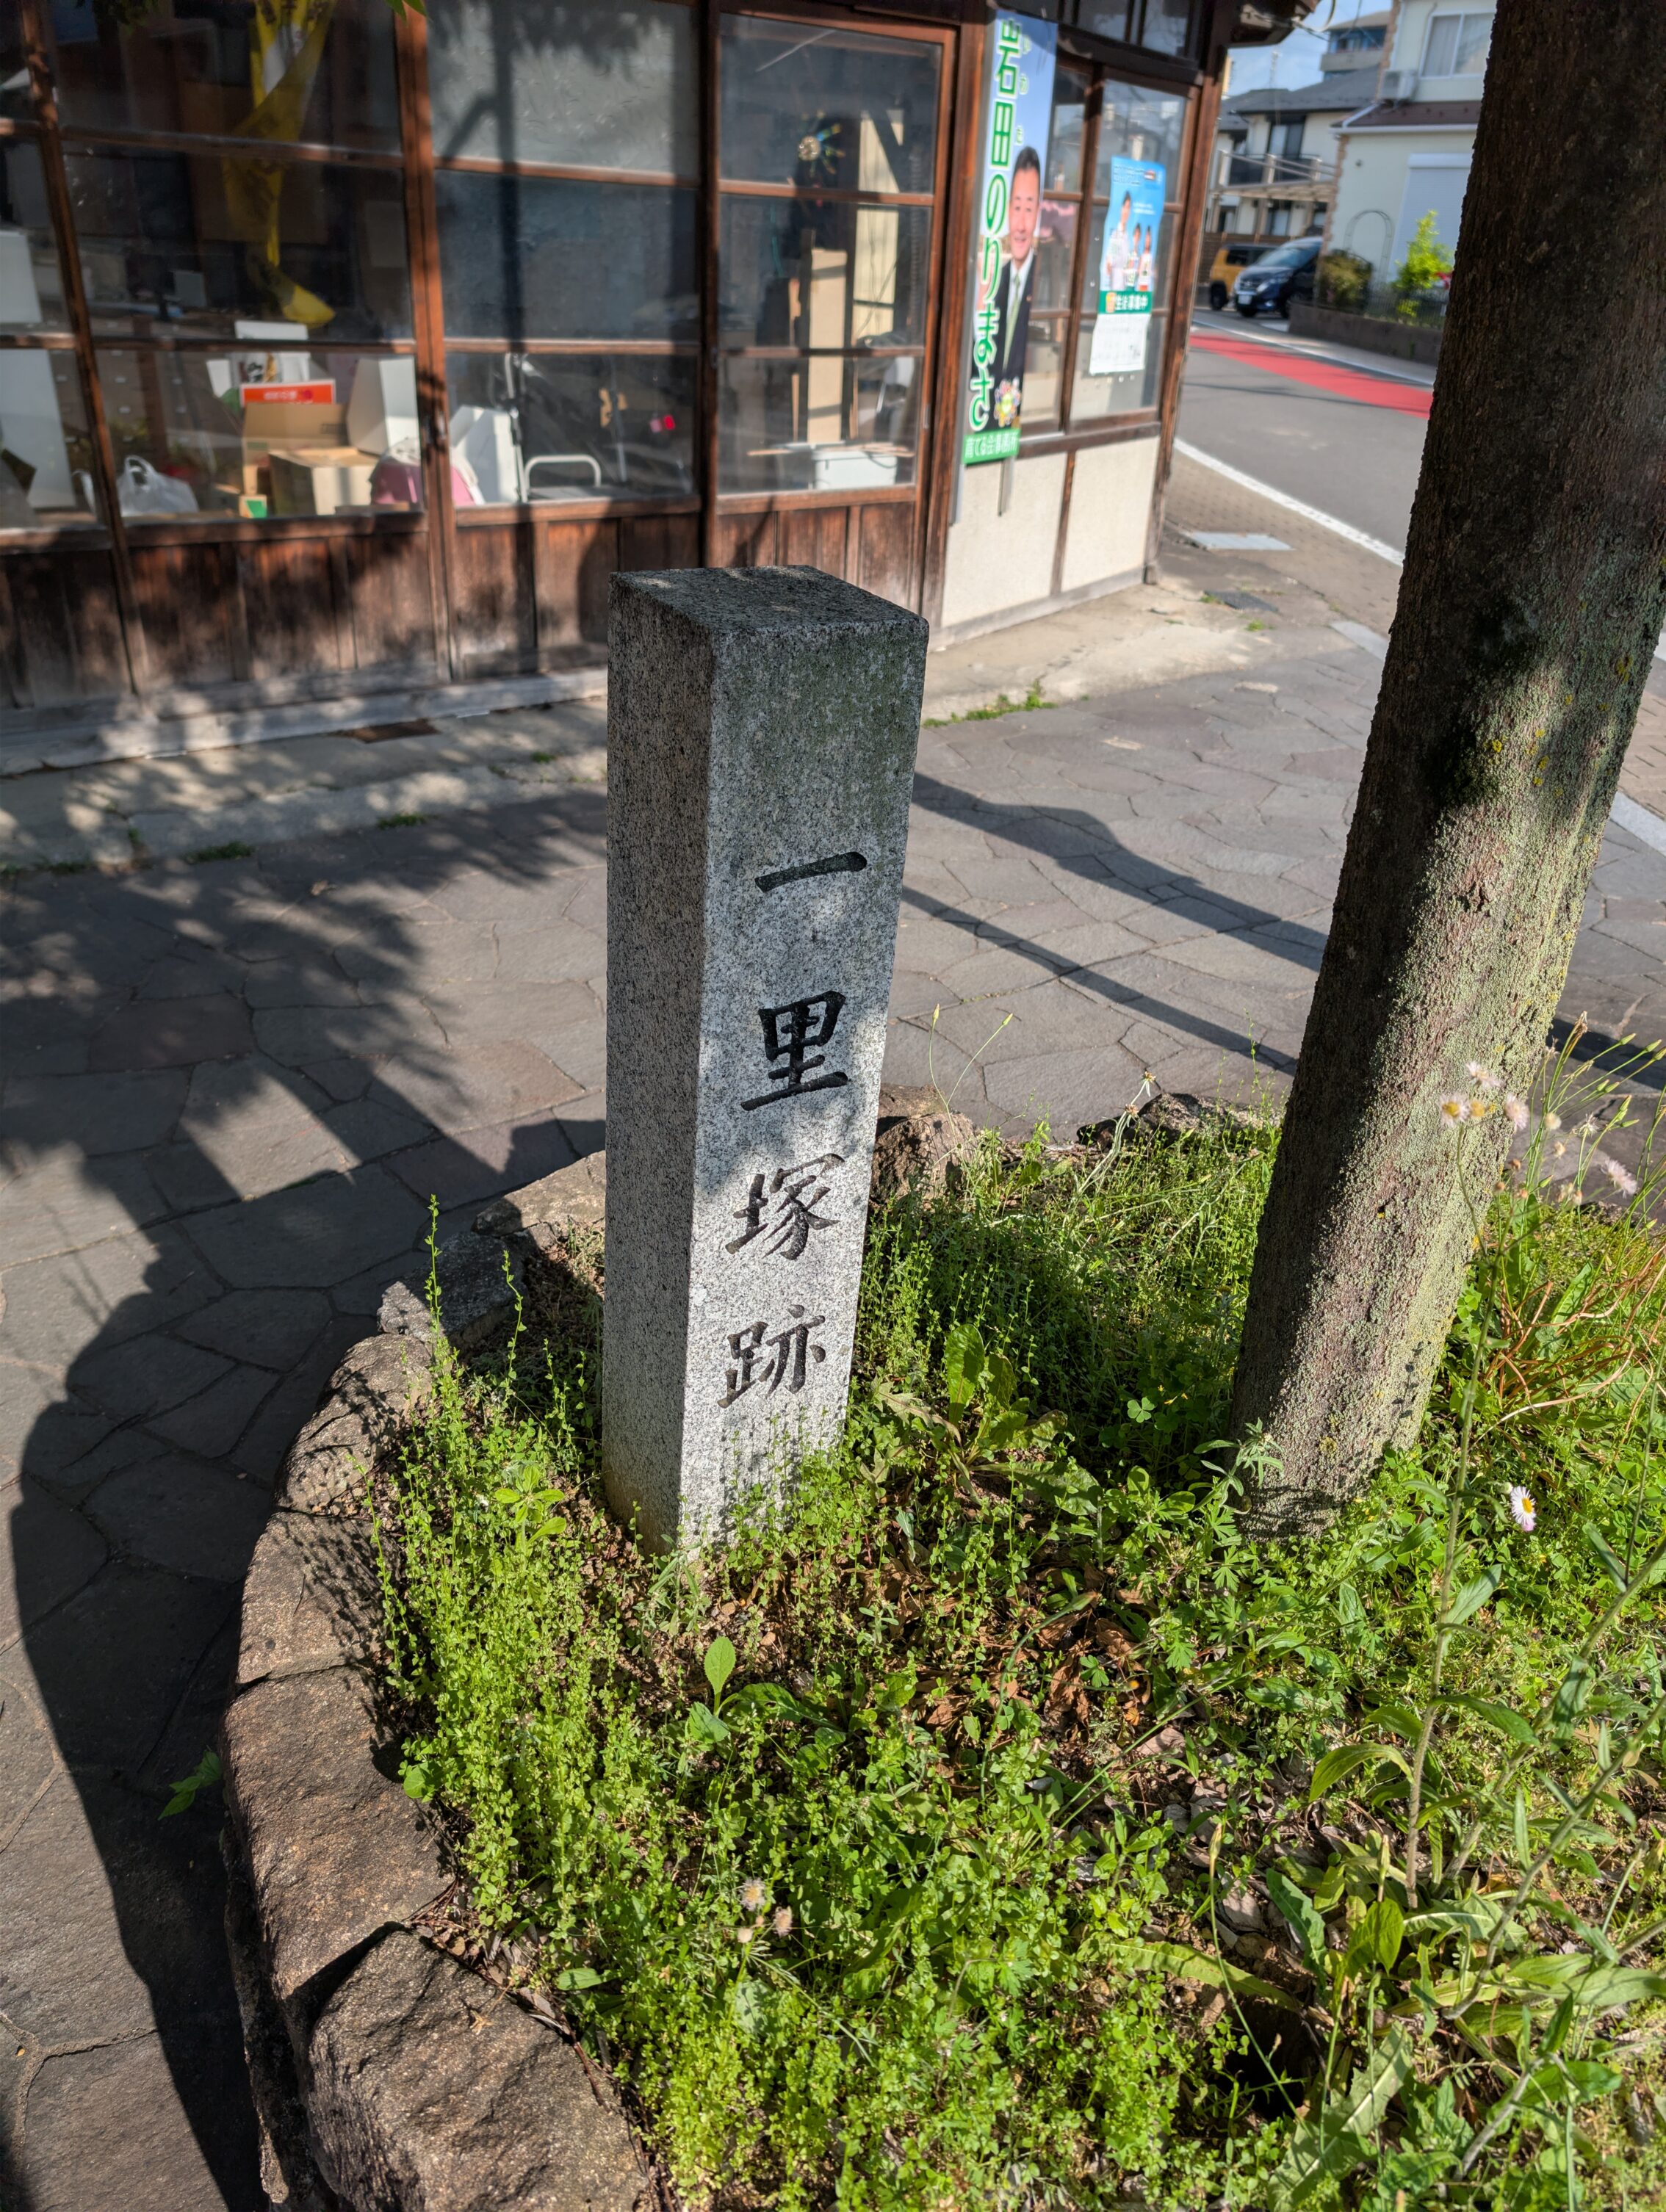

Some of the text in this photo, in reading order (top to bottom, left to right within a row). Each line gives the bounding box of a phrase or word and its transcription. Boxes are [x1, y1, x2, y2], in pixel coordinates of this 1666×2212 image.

[970, 18, 1020, 430] 岩田のりまさ
[717, 851, 868, 1409] 一里塚跡
